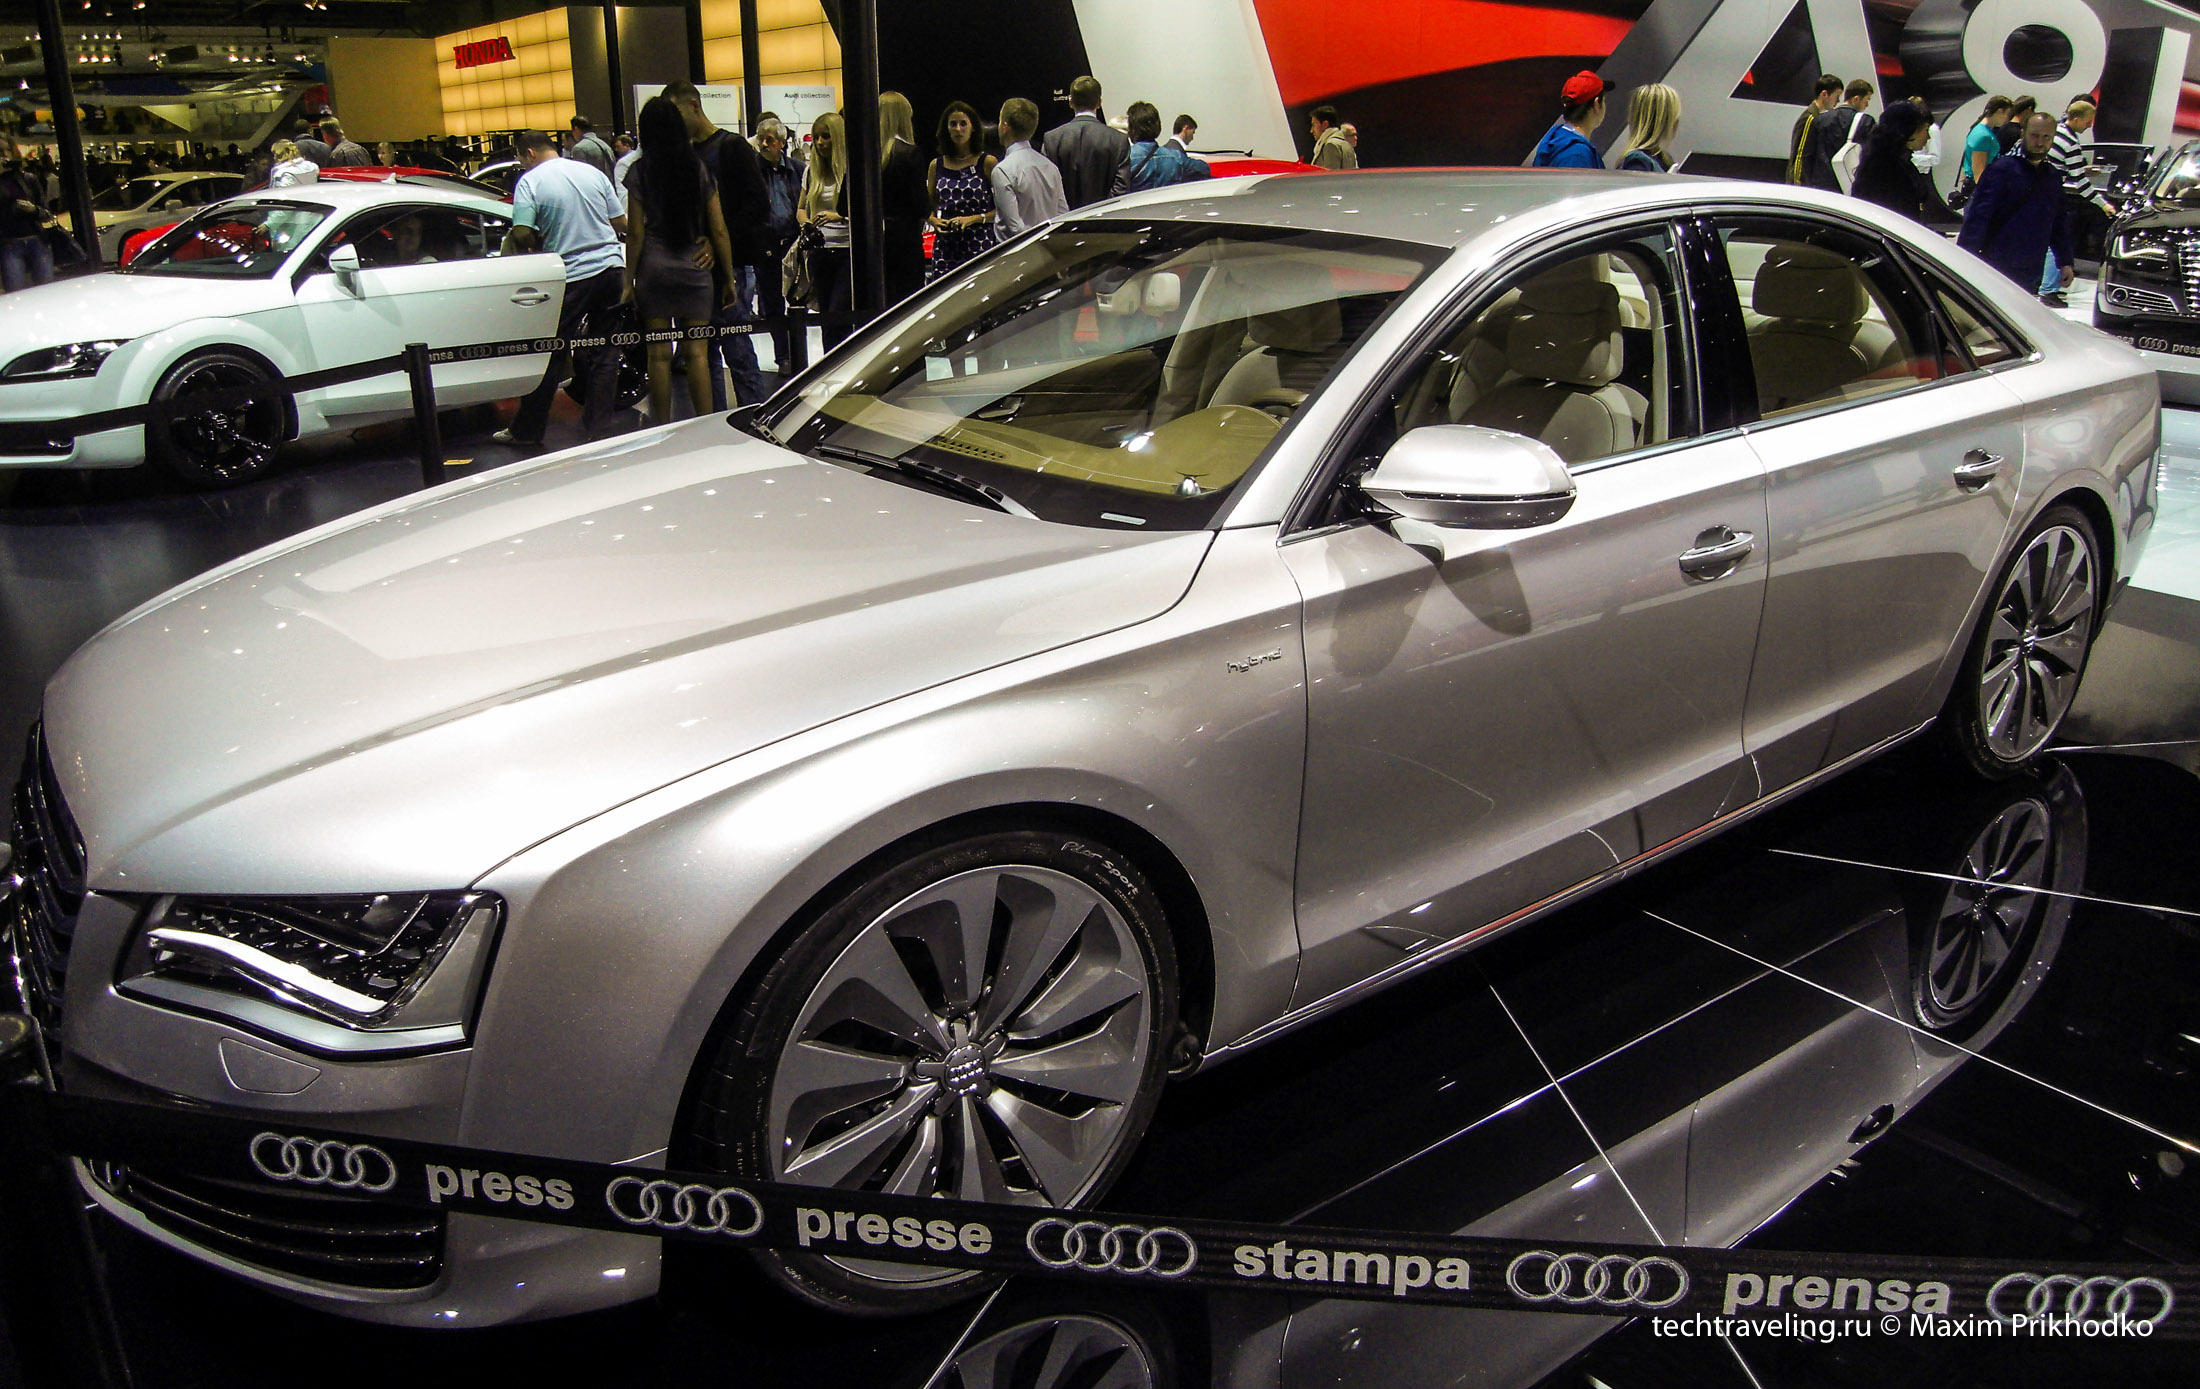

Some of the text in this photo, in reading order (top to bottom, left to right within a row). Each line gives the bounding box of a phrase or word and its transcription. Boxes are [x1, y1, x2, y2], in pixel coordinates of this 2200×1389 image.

[453, 36, 516, 69] HONDA
[497, 343, 529, 355] press
[570, 336, 606, 349] presse
[645, 330, 684, 342] stampa
[720, 324, 753, 336] prensa
[1226, 647, 1281, 673] hybrid
[425, 1163, 1951, 1315] press presse stampa prensa
